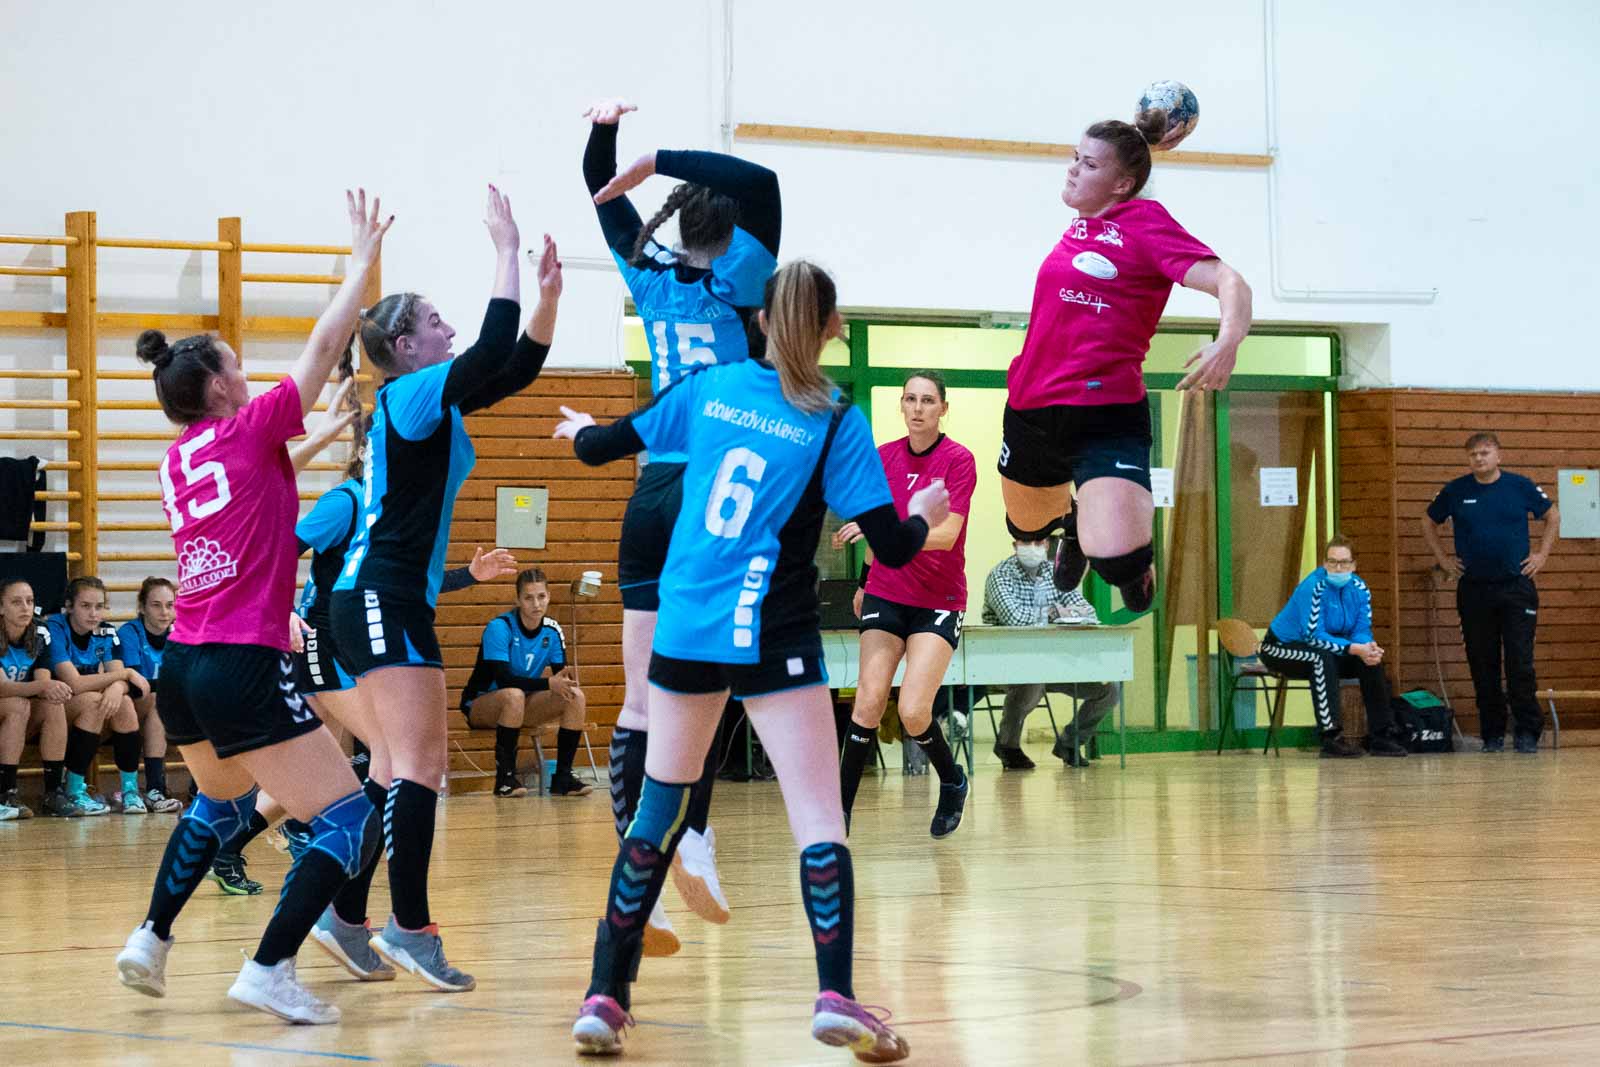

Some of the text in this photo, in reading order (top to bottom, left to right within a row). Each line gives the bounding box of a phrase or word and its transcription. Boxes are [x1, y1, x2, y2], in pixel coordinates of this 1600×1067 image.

[159, 427, 233, 534] 15
[906, 473, 920, 491] 7
[704, 446, 768, 539] 6
[933, 608, 951, 626] 7
[525, 653, 535, 672] 7
